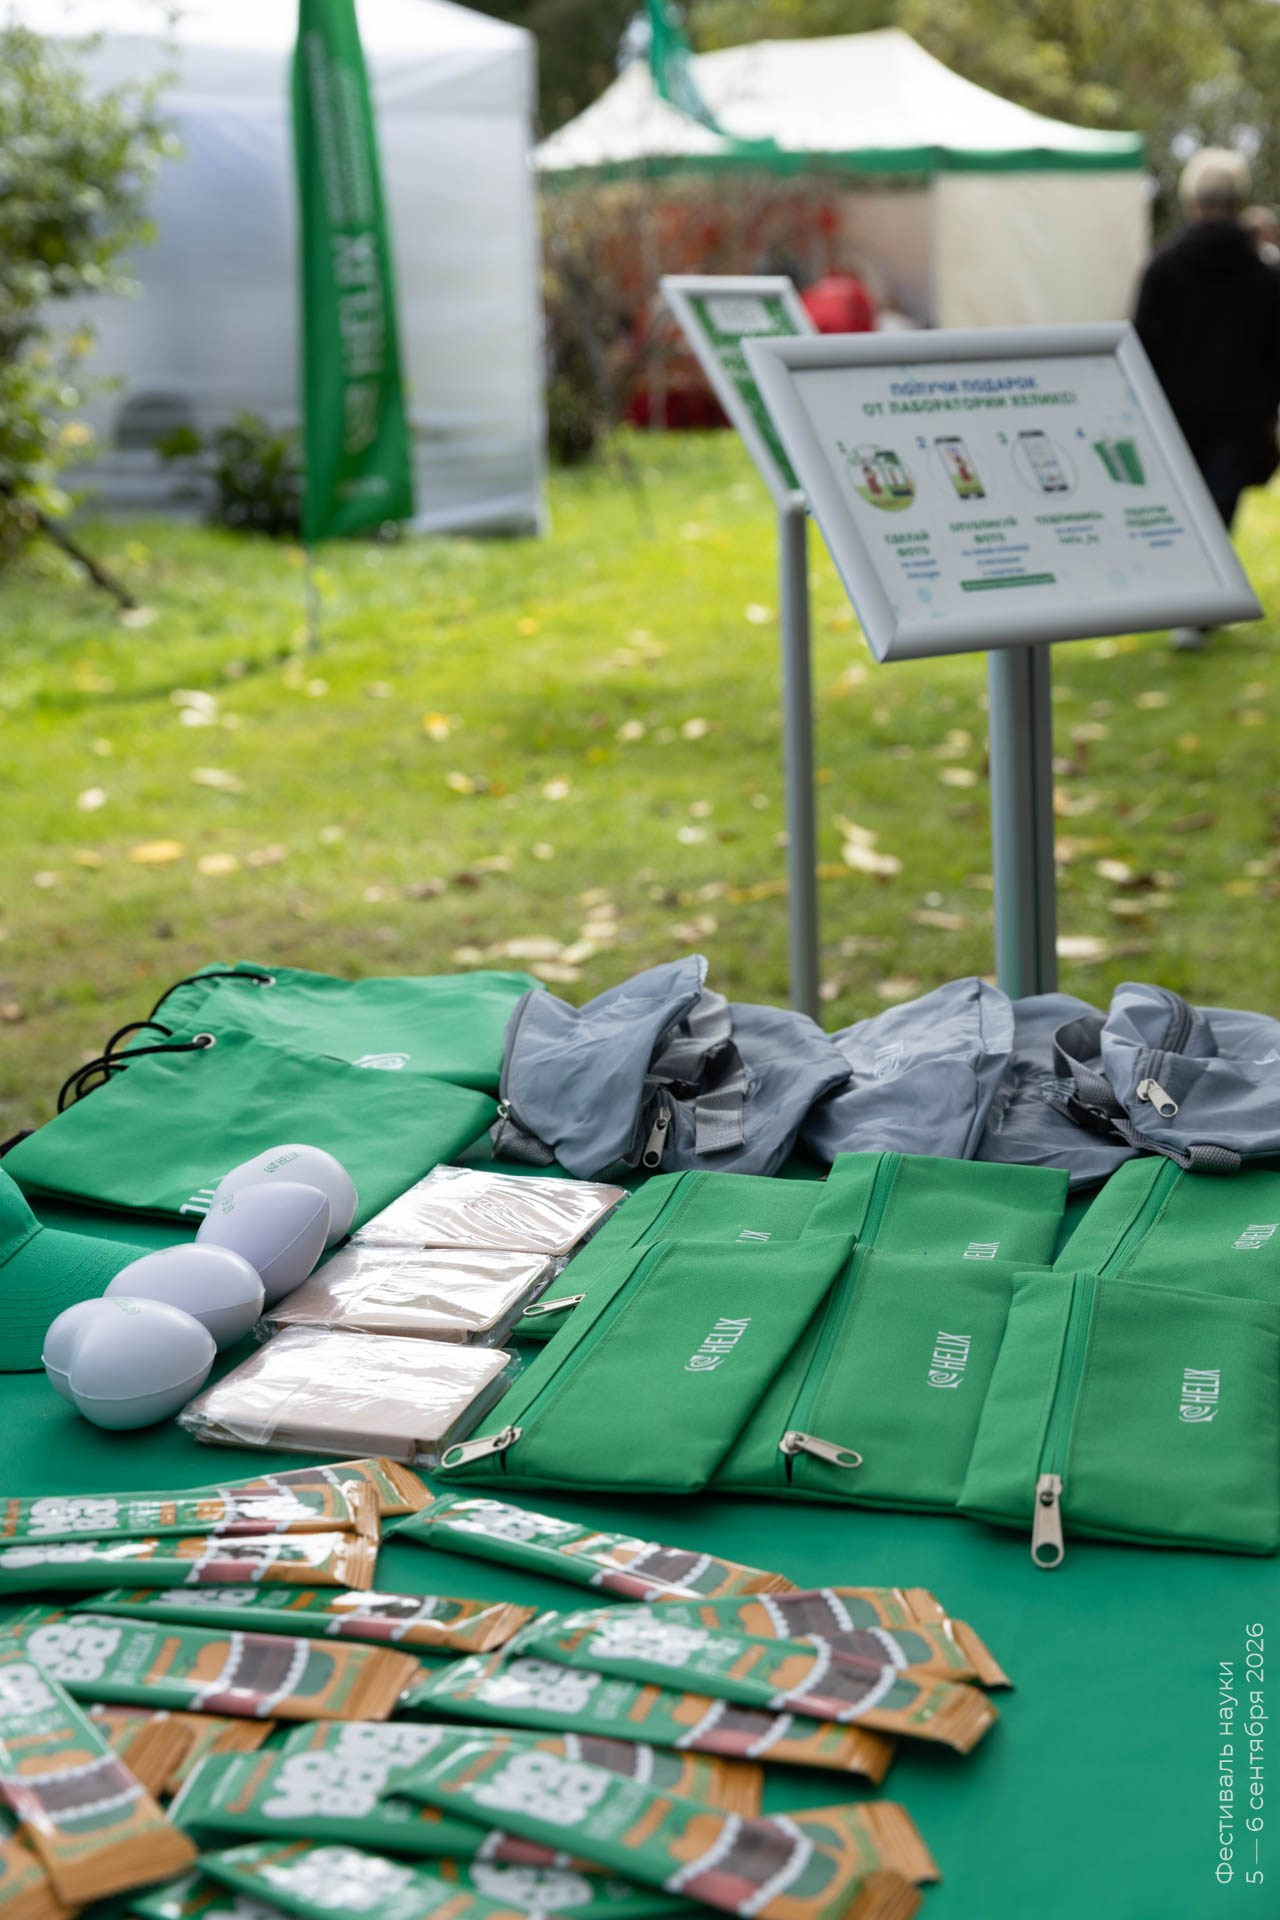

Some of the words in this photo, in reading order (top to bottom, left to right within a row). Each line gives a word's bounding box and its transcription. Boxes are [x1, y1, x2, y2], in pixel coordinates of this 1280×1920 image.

[960, 376, 1037, 394] ПОДАРОК
[1237, 1223, 1280, 1242] HELIX
[697, 1317, 752, 1354] HELIX
[930, 1330, 972, 1372] HELIX
[1181, 1367, 1221, 1405] HELIX
